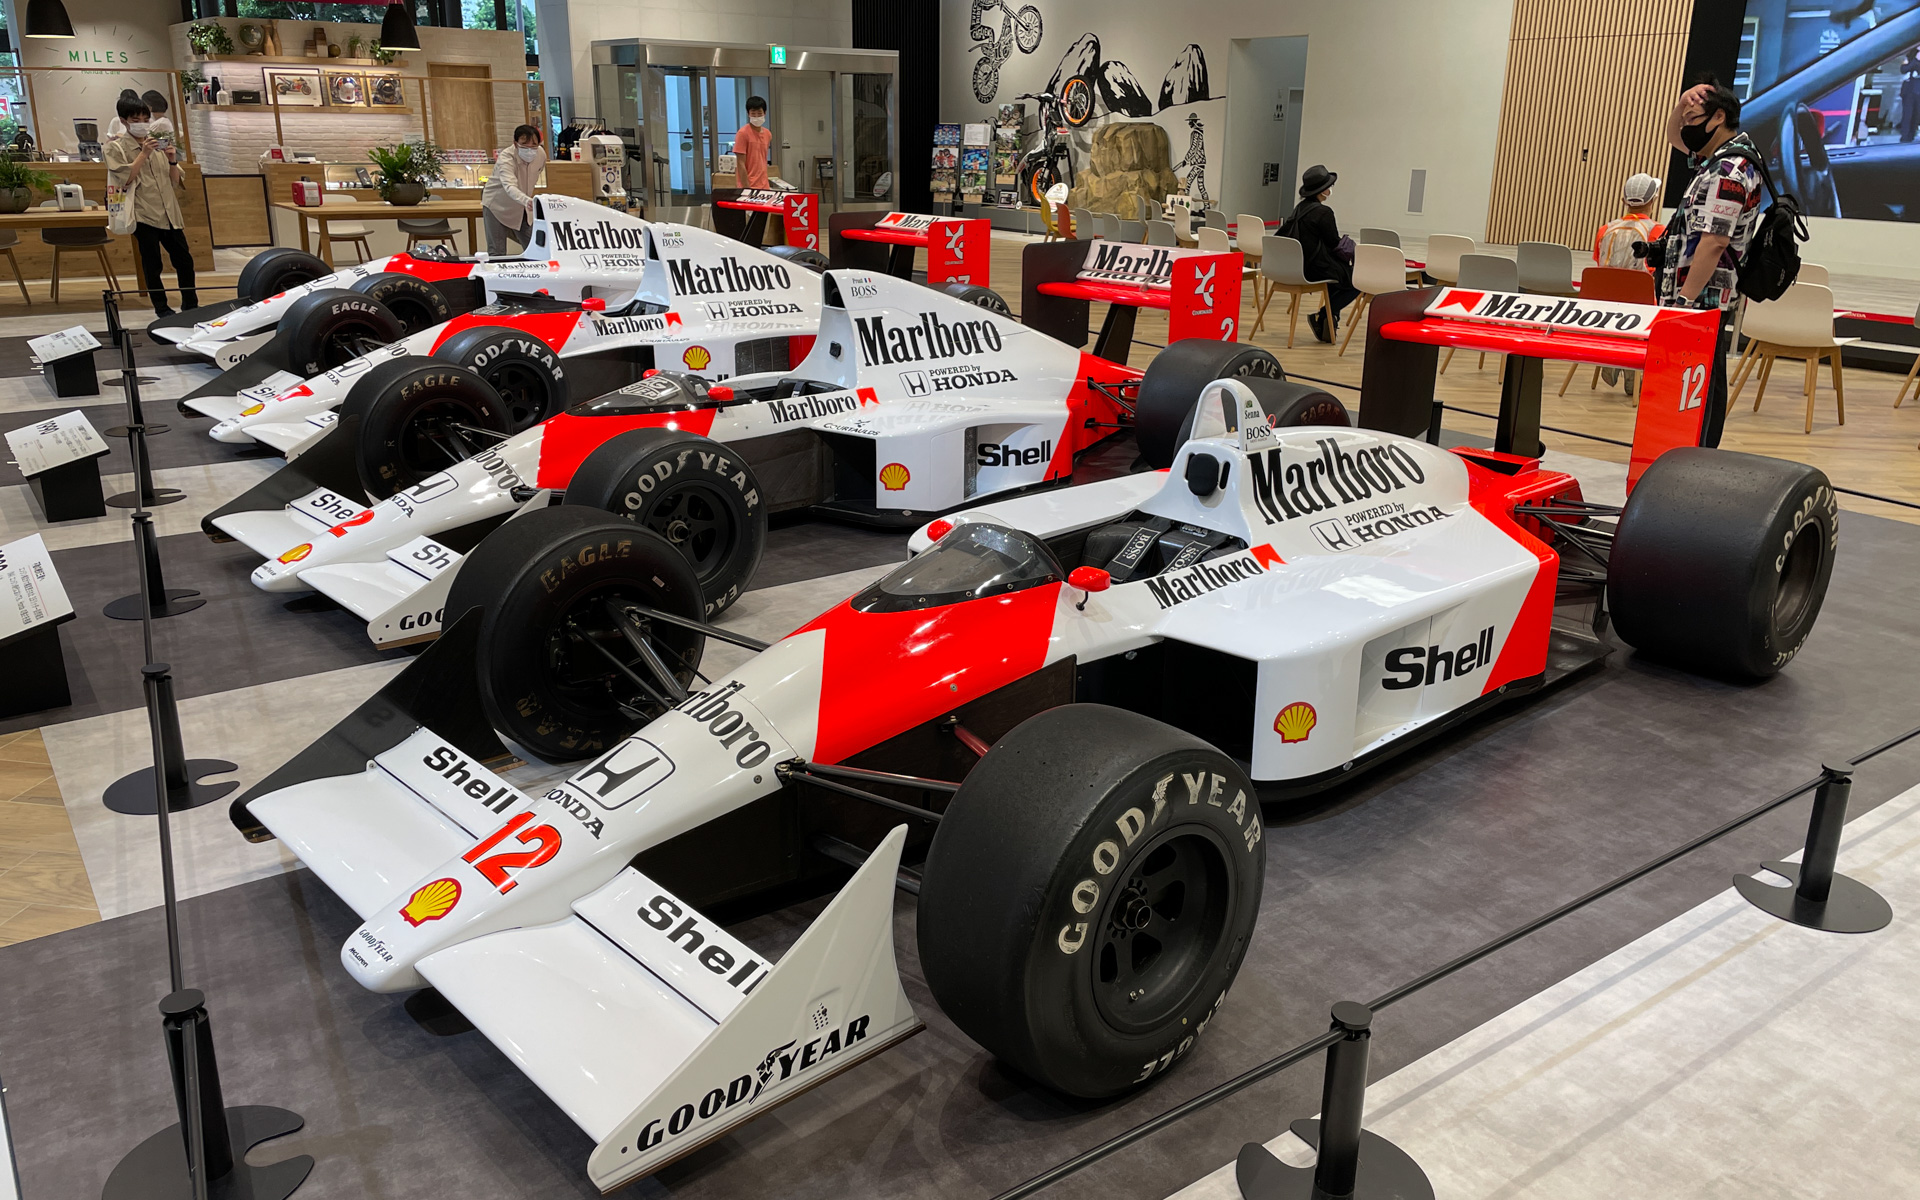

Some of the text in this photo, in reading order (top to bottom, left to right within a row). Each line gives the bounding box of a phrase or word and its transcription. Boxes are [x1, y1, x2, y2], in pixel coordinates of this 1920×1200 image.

[69, 50, 128, 63] MILES
[662, 238, 684, 247] BOSS
[806, 234, 817, 251] 2
[498, 262, 547, 271] Marlboro
[667, 257, 791, 296] Marlboro
[851, 285, 877, 297] BOSS
[332, 301, 379, 315] EAGLE
[730, 303, 803, 318] HONDA
[1475, 294, 1641, 331] Marlboro
[592, 317, 664, 337] Marlboro
[854, 312, 1002, 367] Marlboro
[929, 365, 981, 377] POWERED by
[932, 369, 1018, 392] HONDA
[401, 374, 460, 401] EAGLE
[1678, 363, 1706, 412] 12
[767, 396, 857, 424] Marlboro
[1244, 410, 1260, 420] Senna
[823, 423, 880, 436] COURTAULDS
[1246, 425, 1271, 440] BOSS
[978, 439, 1051, 467] Shell
[1247, 437, 1425, 526] Marlboro
[1345, 502, 1406, 526] POWERED by
[1351, 505, 1454, 543] HONDA
[1126, 533, 1151, 560] BOSS
[541, 540, 632, 594] EAGLE
[1144, 556, 1264, 610] Marlboro
[1381, 625, 1495, 691] Shell
[422, 746, 519, 815] Shell
[460, 811, 562, 895] 12
[349, 947, 368, 968] McLaren
